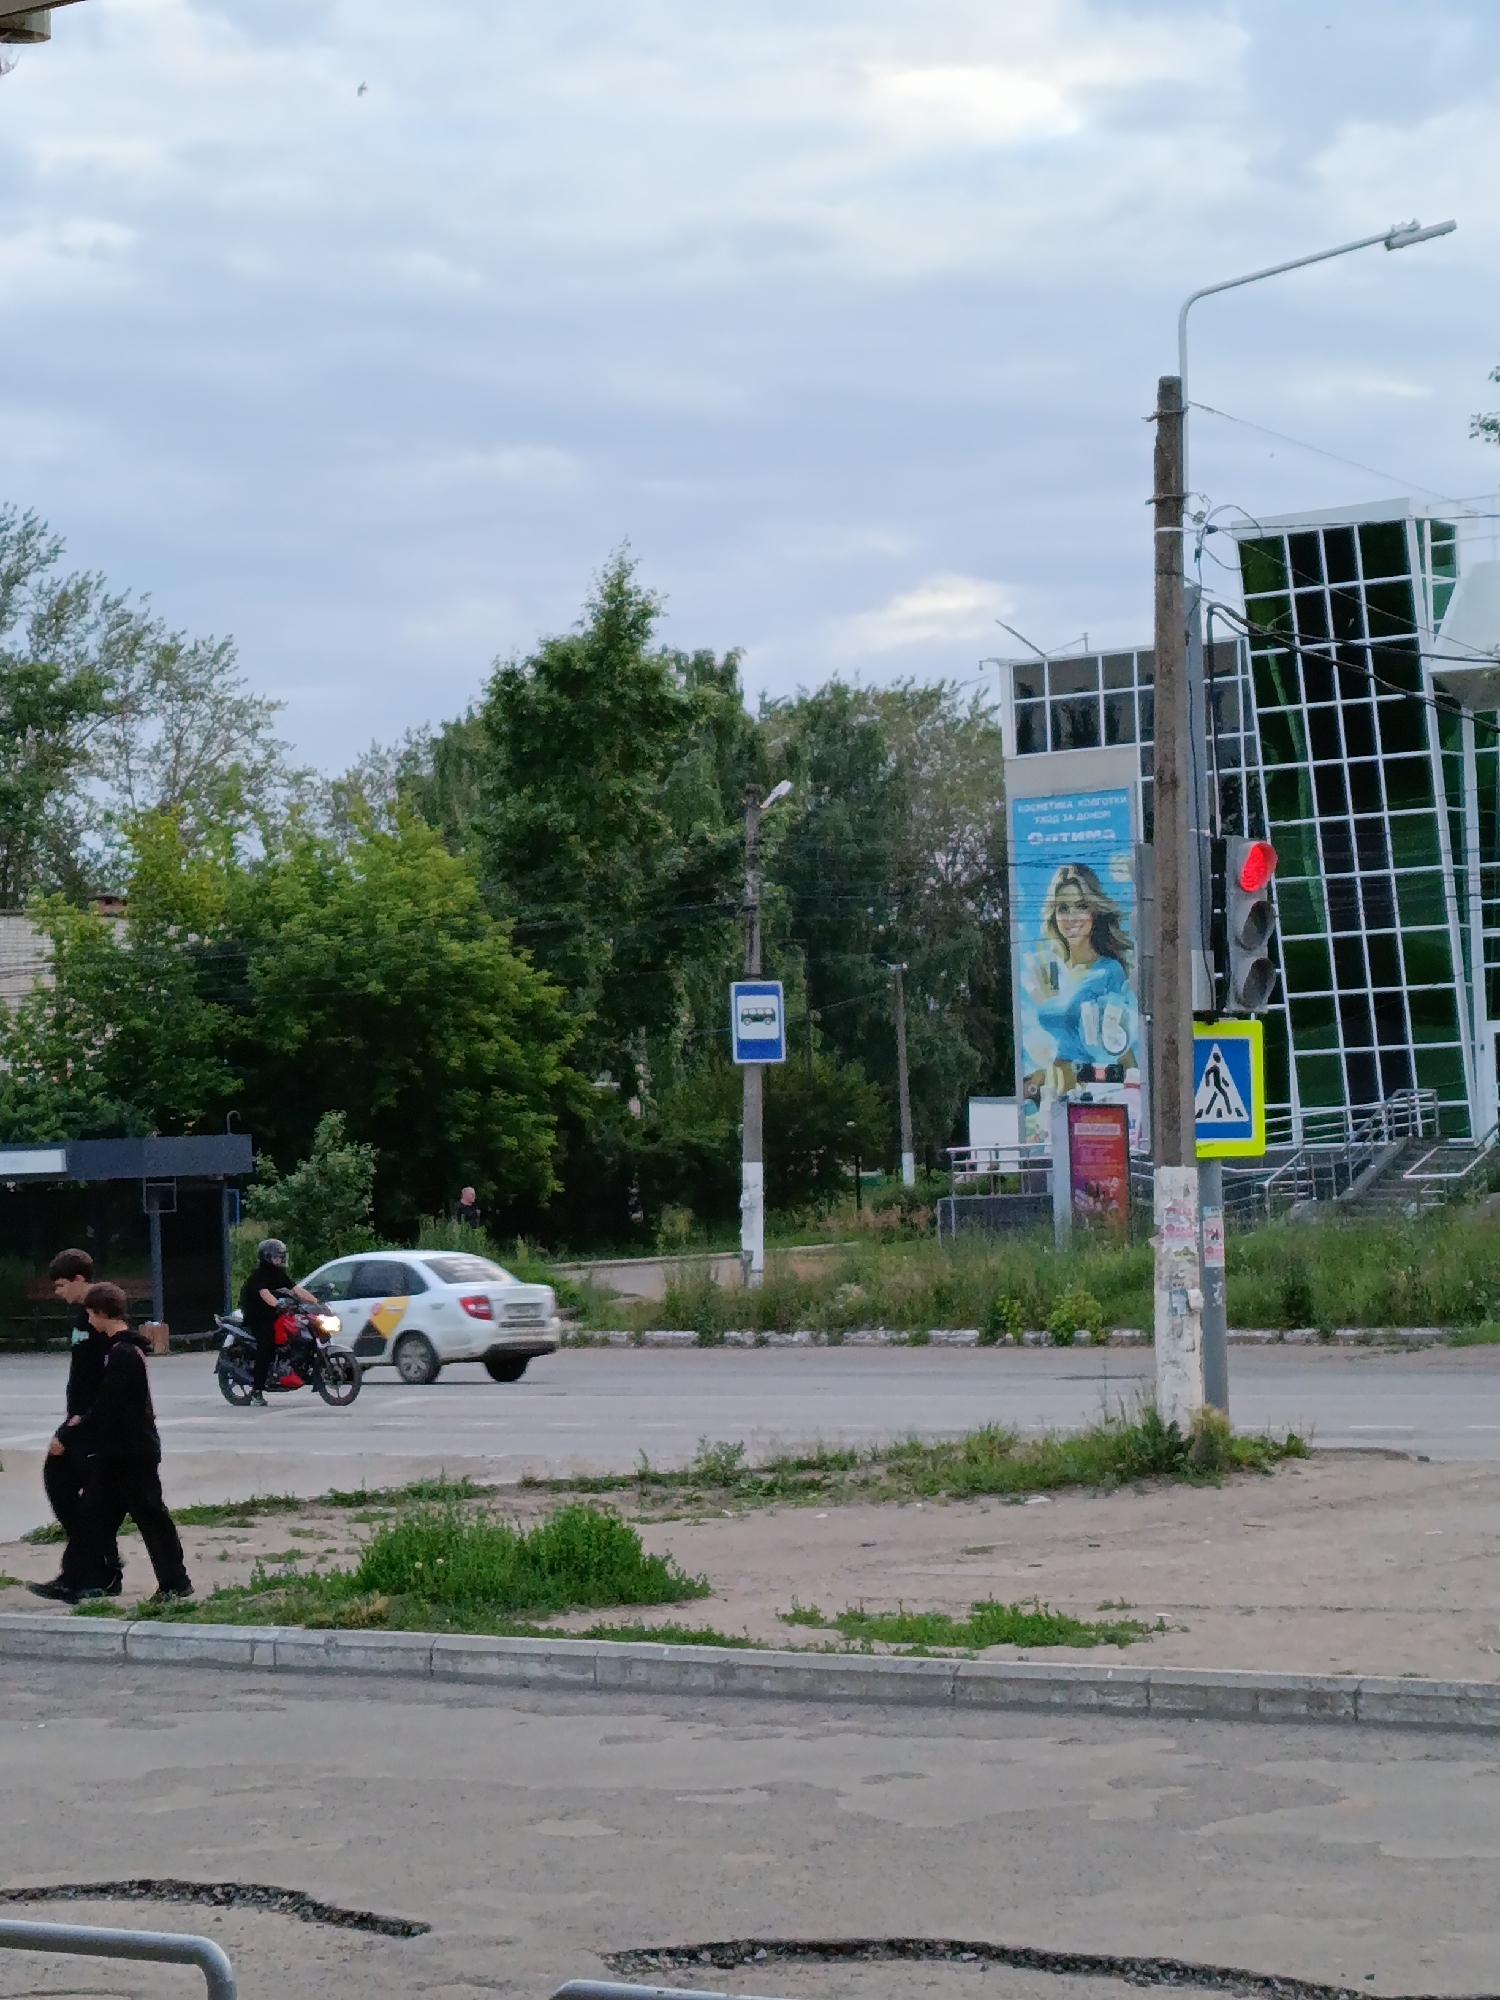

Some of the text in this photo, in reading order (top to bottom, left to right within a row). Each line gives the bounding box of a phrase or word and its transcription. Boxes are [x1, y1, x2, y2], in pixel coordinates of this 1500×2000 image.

[1018, 797, 1127, 812] КОСМЕТИКА КОЛГОТКИ
[1034, 815, 1059, 824] УХОД
[1063, 814, 1074, 822] ЗА
